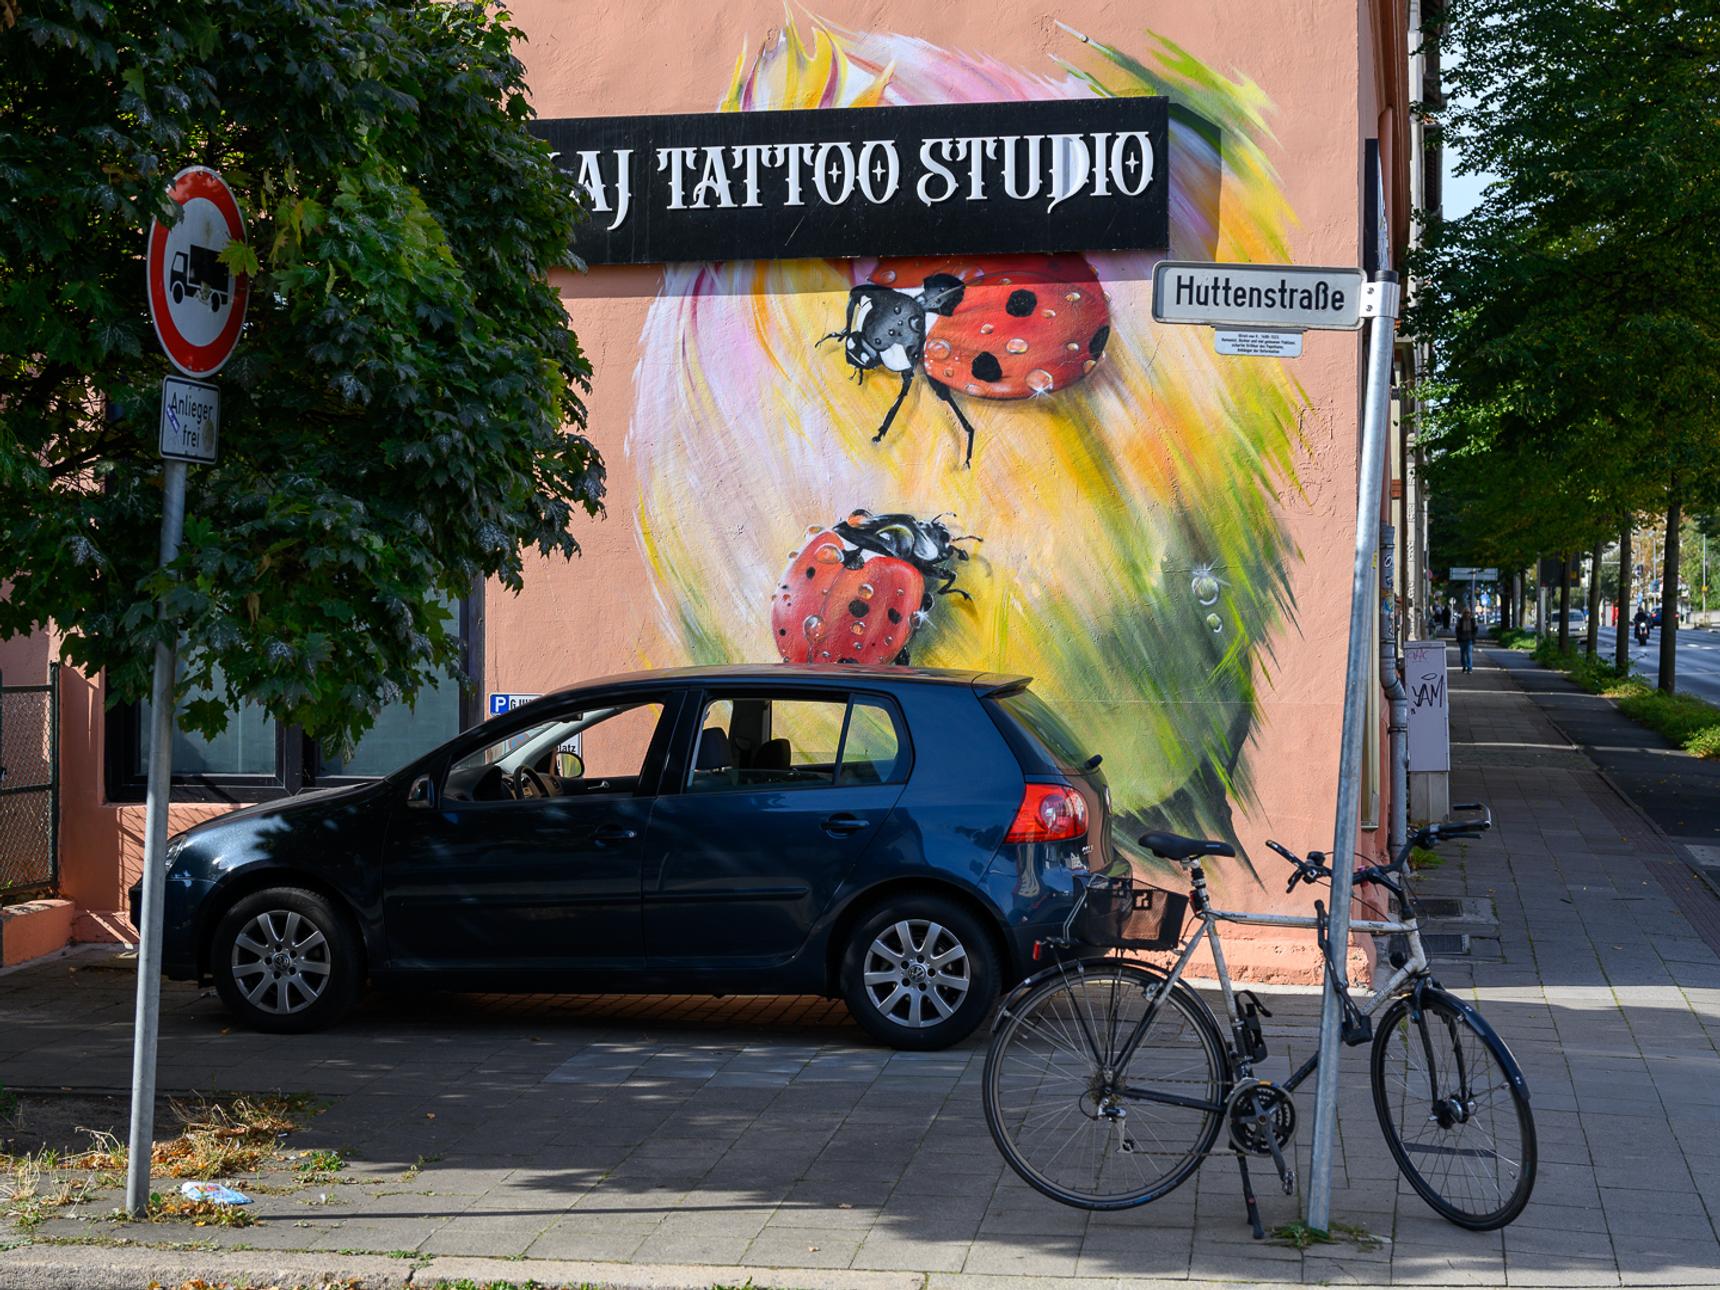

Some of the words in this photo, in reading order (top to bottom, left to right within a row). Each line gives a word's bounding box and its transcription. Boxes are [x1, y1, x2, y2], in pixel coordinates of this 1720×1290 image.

[547, 149, 634, 231] AJ
[656, 140, 900, 209] TATTOO
[916, 131, 1154, 214] STUDIO
[1176, 275, 1345, 311] Huttenstraße
[171, 392, 213, 424] Anlieger
[183, 424, 200, 448] frei
